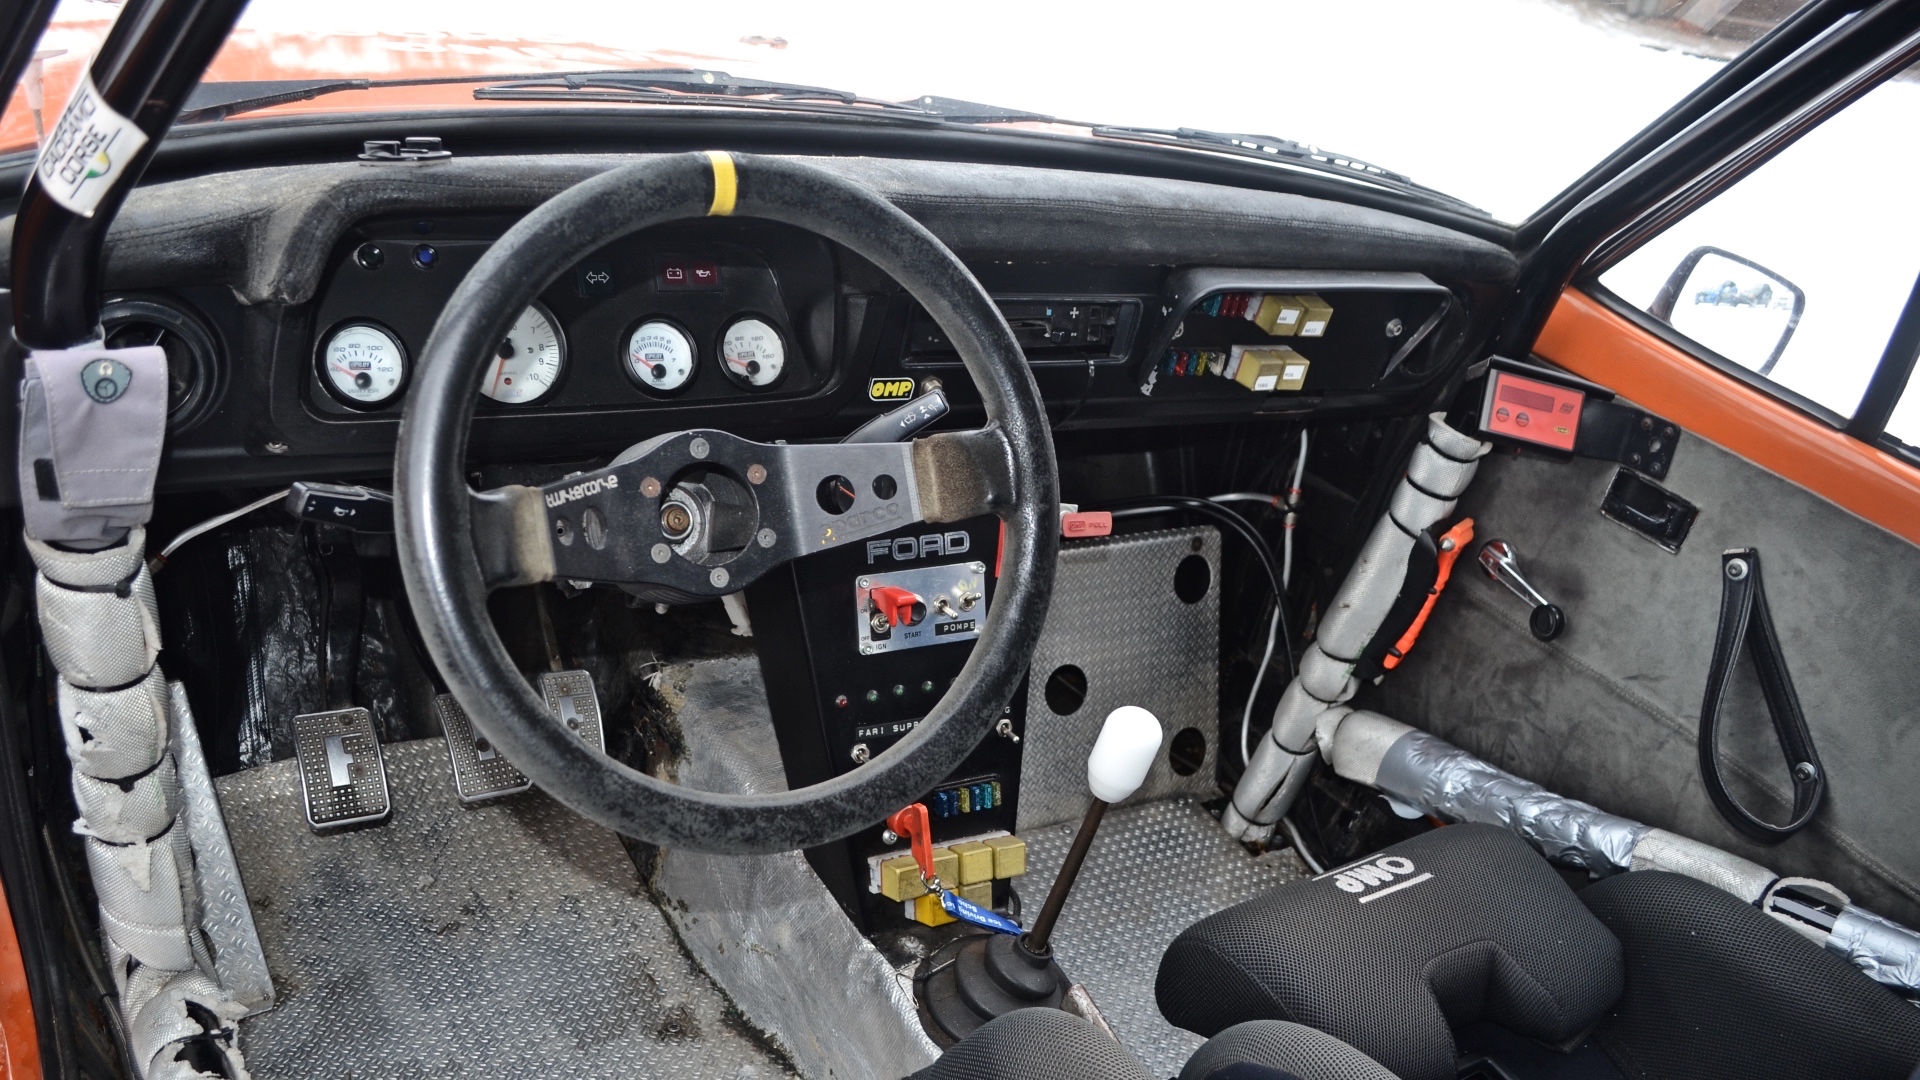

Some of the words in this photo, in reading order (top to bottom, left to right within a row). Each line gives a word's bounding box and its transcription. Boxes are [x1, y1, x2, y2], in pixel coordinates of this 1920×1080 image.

[41, 94, 96, 179] CACCAMO
[60, 125, 107, 185] CORSE
[530, 326, 536, 334] 7
[538, 357, 545, 365] 9
[529, 373, 540, 381] 10
[871, 381, 912, 397] OMP
[943, 621, 976, 633] POMPE
[903, 630, 922, 640] START
[858, 726, 884, 738] FARI
[1333, 856, 1415, 893] OMP
[987, 917, 1002, 926] Ice
